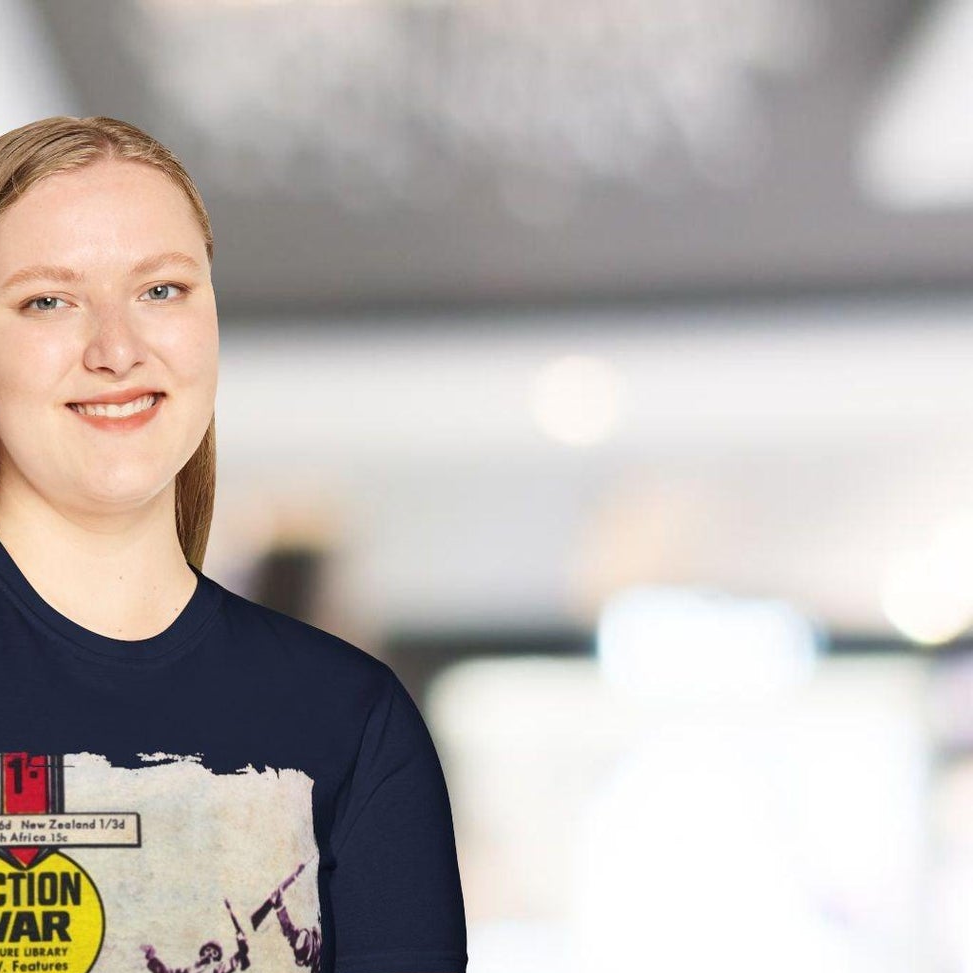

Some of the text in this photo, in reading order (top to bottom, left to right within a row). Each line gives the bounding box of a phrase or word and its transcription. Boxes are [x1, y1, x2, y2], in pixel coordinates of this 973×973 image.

[21, 820, 45, 830] New
[49, 818, 96, 830] Zealand
[99, 818, 125, 830] 1/3d
[10, 832, 46, 843] Africa
[51, 833, 68, 843] 15c
[24, 947, 68, 957] LIBRARY
[12, 961, 68, 972] Features
